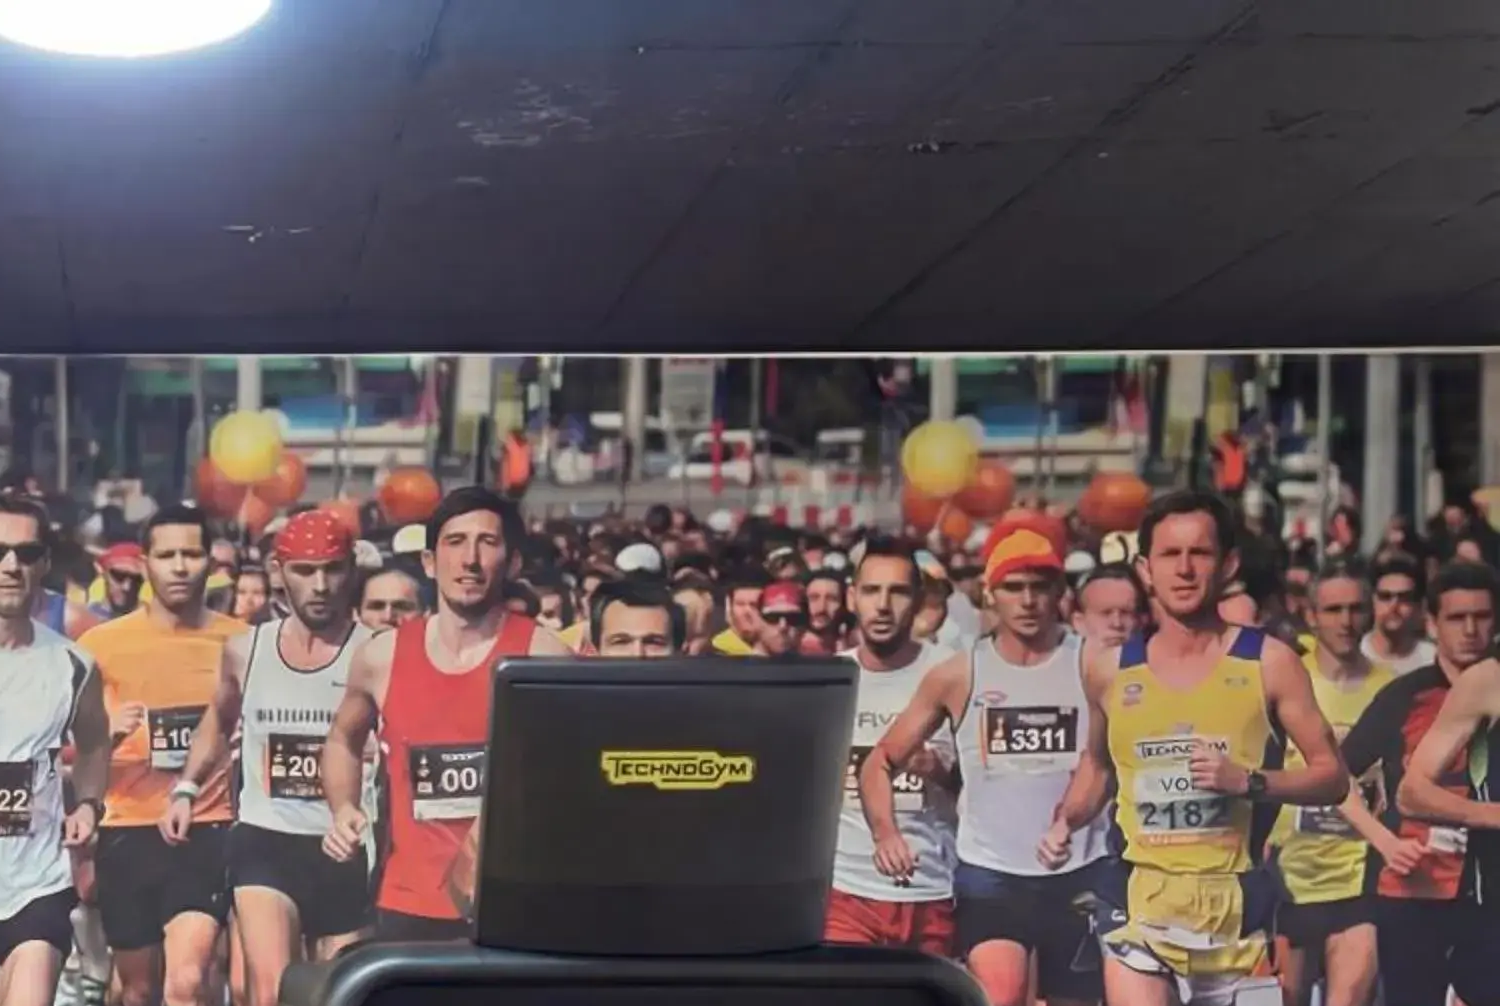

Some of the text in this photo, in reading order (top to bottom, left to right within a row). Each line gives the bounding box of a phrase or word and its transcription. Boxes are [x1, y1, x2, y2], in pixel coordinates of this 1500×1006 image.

[168, 727, 191, 748] 10
[1011, 727, 1065, 751] 5311
[288, 756, 321, 779] 20
[441, 767, 484, 792] 00
[1160, 777, 1196, 792] VO
